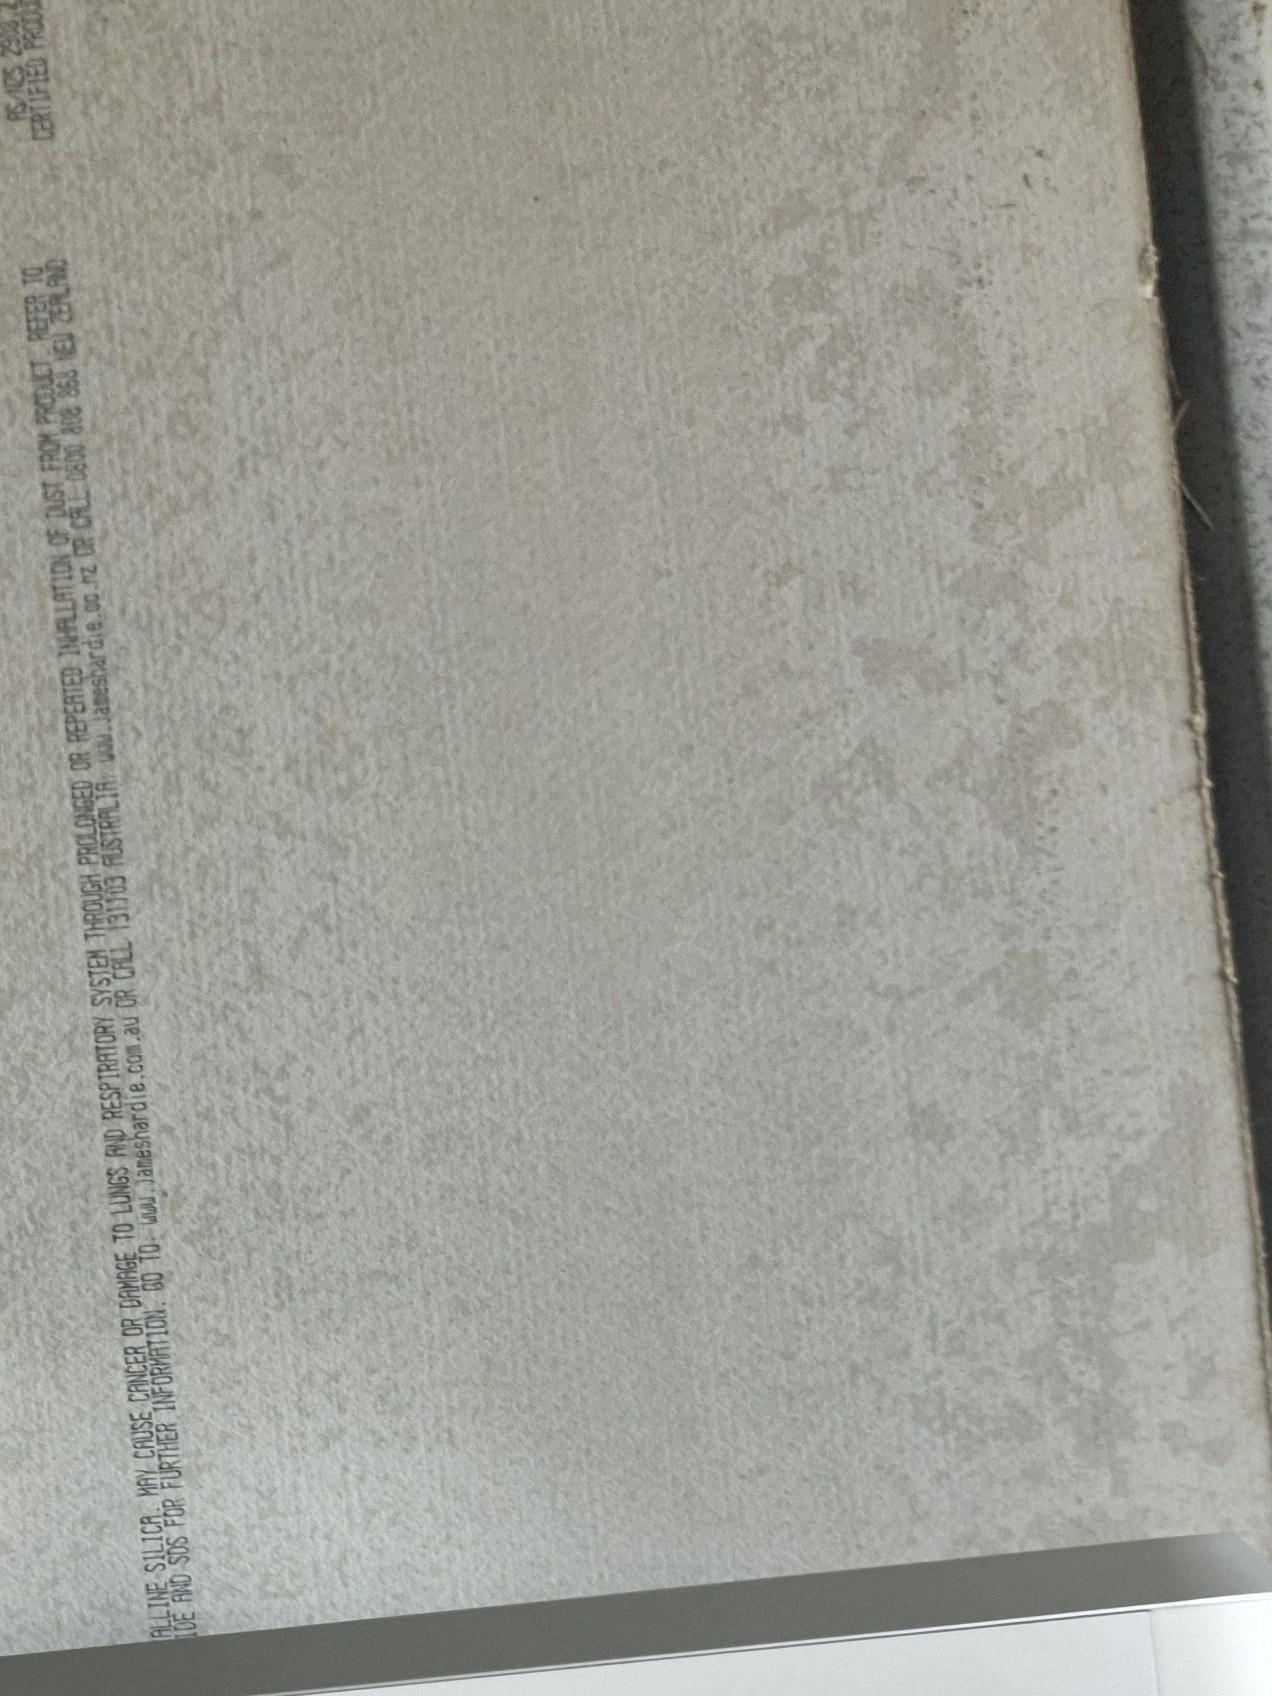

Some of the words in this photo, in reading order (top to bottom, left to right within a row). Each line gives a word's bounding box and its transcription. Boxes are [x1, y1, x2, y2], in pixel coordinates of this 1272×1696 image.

[24, 57, 54, 141] CERTIFIED
[21, 266, 45, 287] TO
[43, 258, 74, 326] ZEALAND
[24, 295, 50, 342] REFER
[37, 433, 62, 472] FROM
[41, 481, 67, 519] DUST
[67, 490, 93, 530] CALL
[46, 528, 70, 547] OF
[71, 537, 96, 557] OR
[60, 667, 88, 743] REPEATED
[68, 752, 92, 771] OR
[70, 780, 99, 866] PROLONGED
[79, 873, 106, 941] THROUGH
[86, 949, 113, 1007] SYSTEM
[109, 941, 135, 980] CALL
[113, 989, 138, 1008] OR
[92, 1016, 124, 1120] RESPIRATORY
[103, 1129, 126, 1157] AND
[106, 1166, 132, 1214] LUNGS
[111, 1223, 134, 1244] TO
[113, 1252, 141, 1309] DAMAGE
[140, 1272, 165, 1292] GO
[121, 1318, 143, 1337] OR
[122, 1346, 150, 1403] CANCER
[143, 1301, 177, 1412] INFORMATION.
[129, 1412, 155, 1460] CAUSE
[155, 1424, 183, 1490] FURTHER
[136, 1469, 158, 1497] MAY
[162, 1499, 187, 1527] FOR
[166, 1536, 191, 1565] SDS
[169, 1573, 195, 1603] AND
